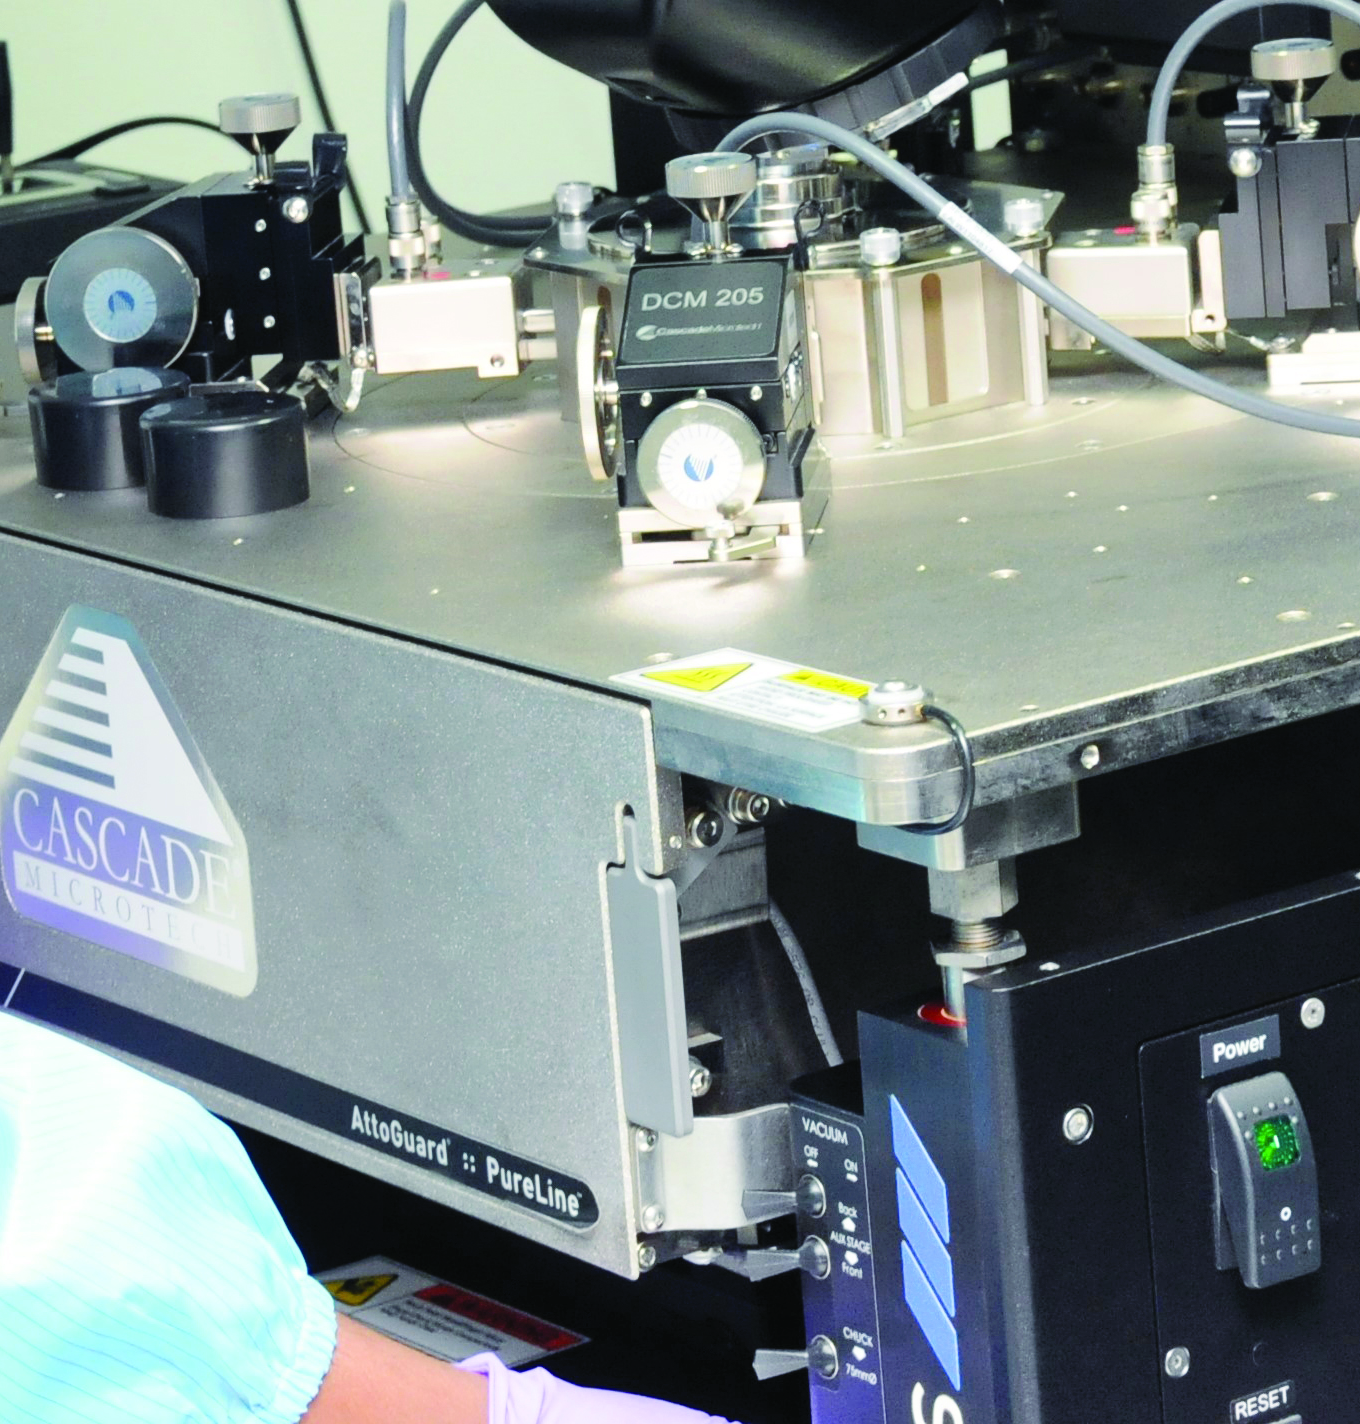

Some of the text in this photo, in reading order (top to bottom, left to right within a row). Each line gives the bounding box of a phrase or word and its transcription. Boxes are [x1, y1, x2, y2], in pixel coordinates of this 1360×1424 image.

[641, 287, 764, 312] DCM 205
[13, 788, 237, 919] CASCADE
[24, 861, 233, 961] MICROTECH
[1213, 1034, 1267, 1063] Power
[802, 1116, 848, 1146] VACUUM
[803, 1144, 858, 1173] OFF ON
[838, 1201, 858, 1219] Back
[830, 1230, 871, 1255] AUX STAGE
[841, 1261, 863, 1279] Front
[842, 1326, 874, 1348] CHUCK
[1234, 1384, 1290, 1421] RESET
